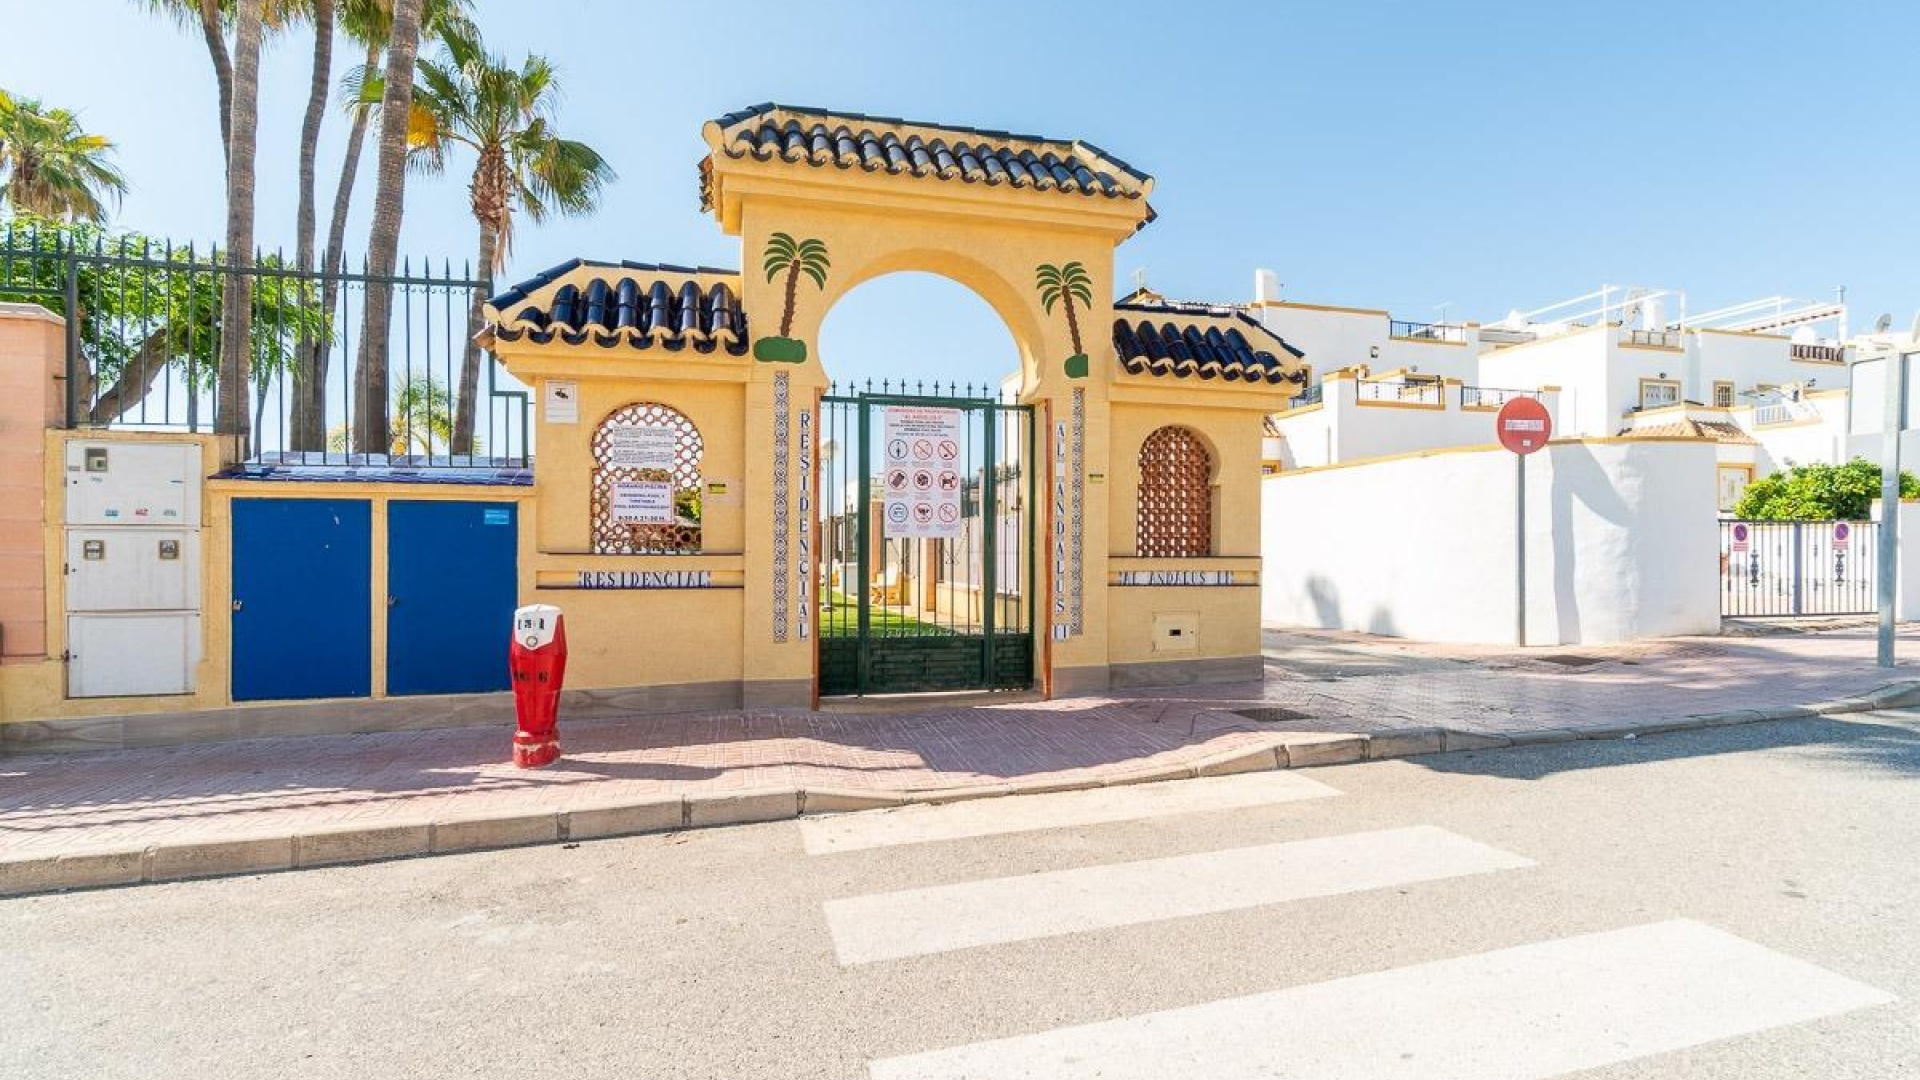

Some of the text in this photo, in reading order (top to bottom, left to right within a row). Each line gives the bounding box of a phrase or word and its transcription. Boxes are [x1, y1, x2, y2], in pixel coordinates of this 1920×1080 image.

[1057, 423, 1065, 461] AL
[799, 413, 810, 641] RESIDENCIAL
[1056, 483, 1065, 614] ANDALUS
[583, 571, 707, 588] RESIDENCIAL
